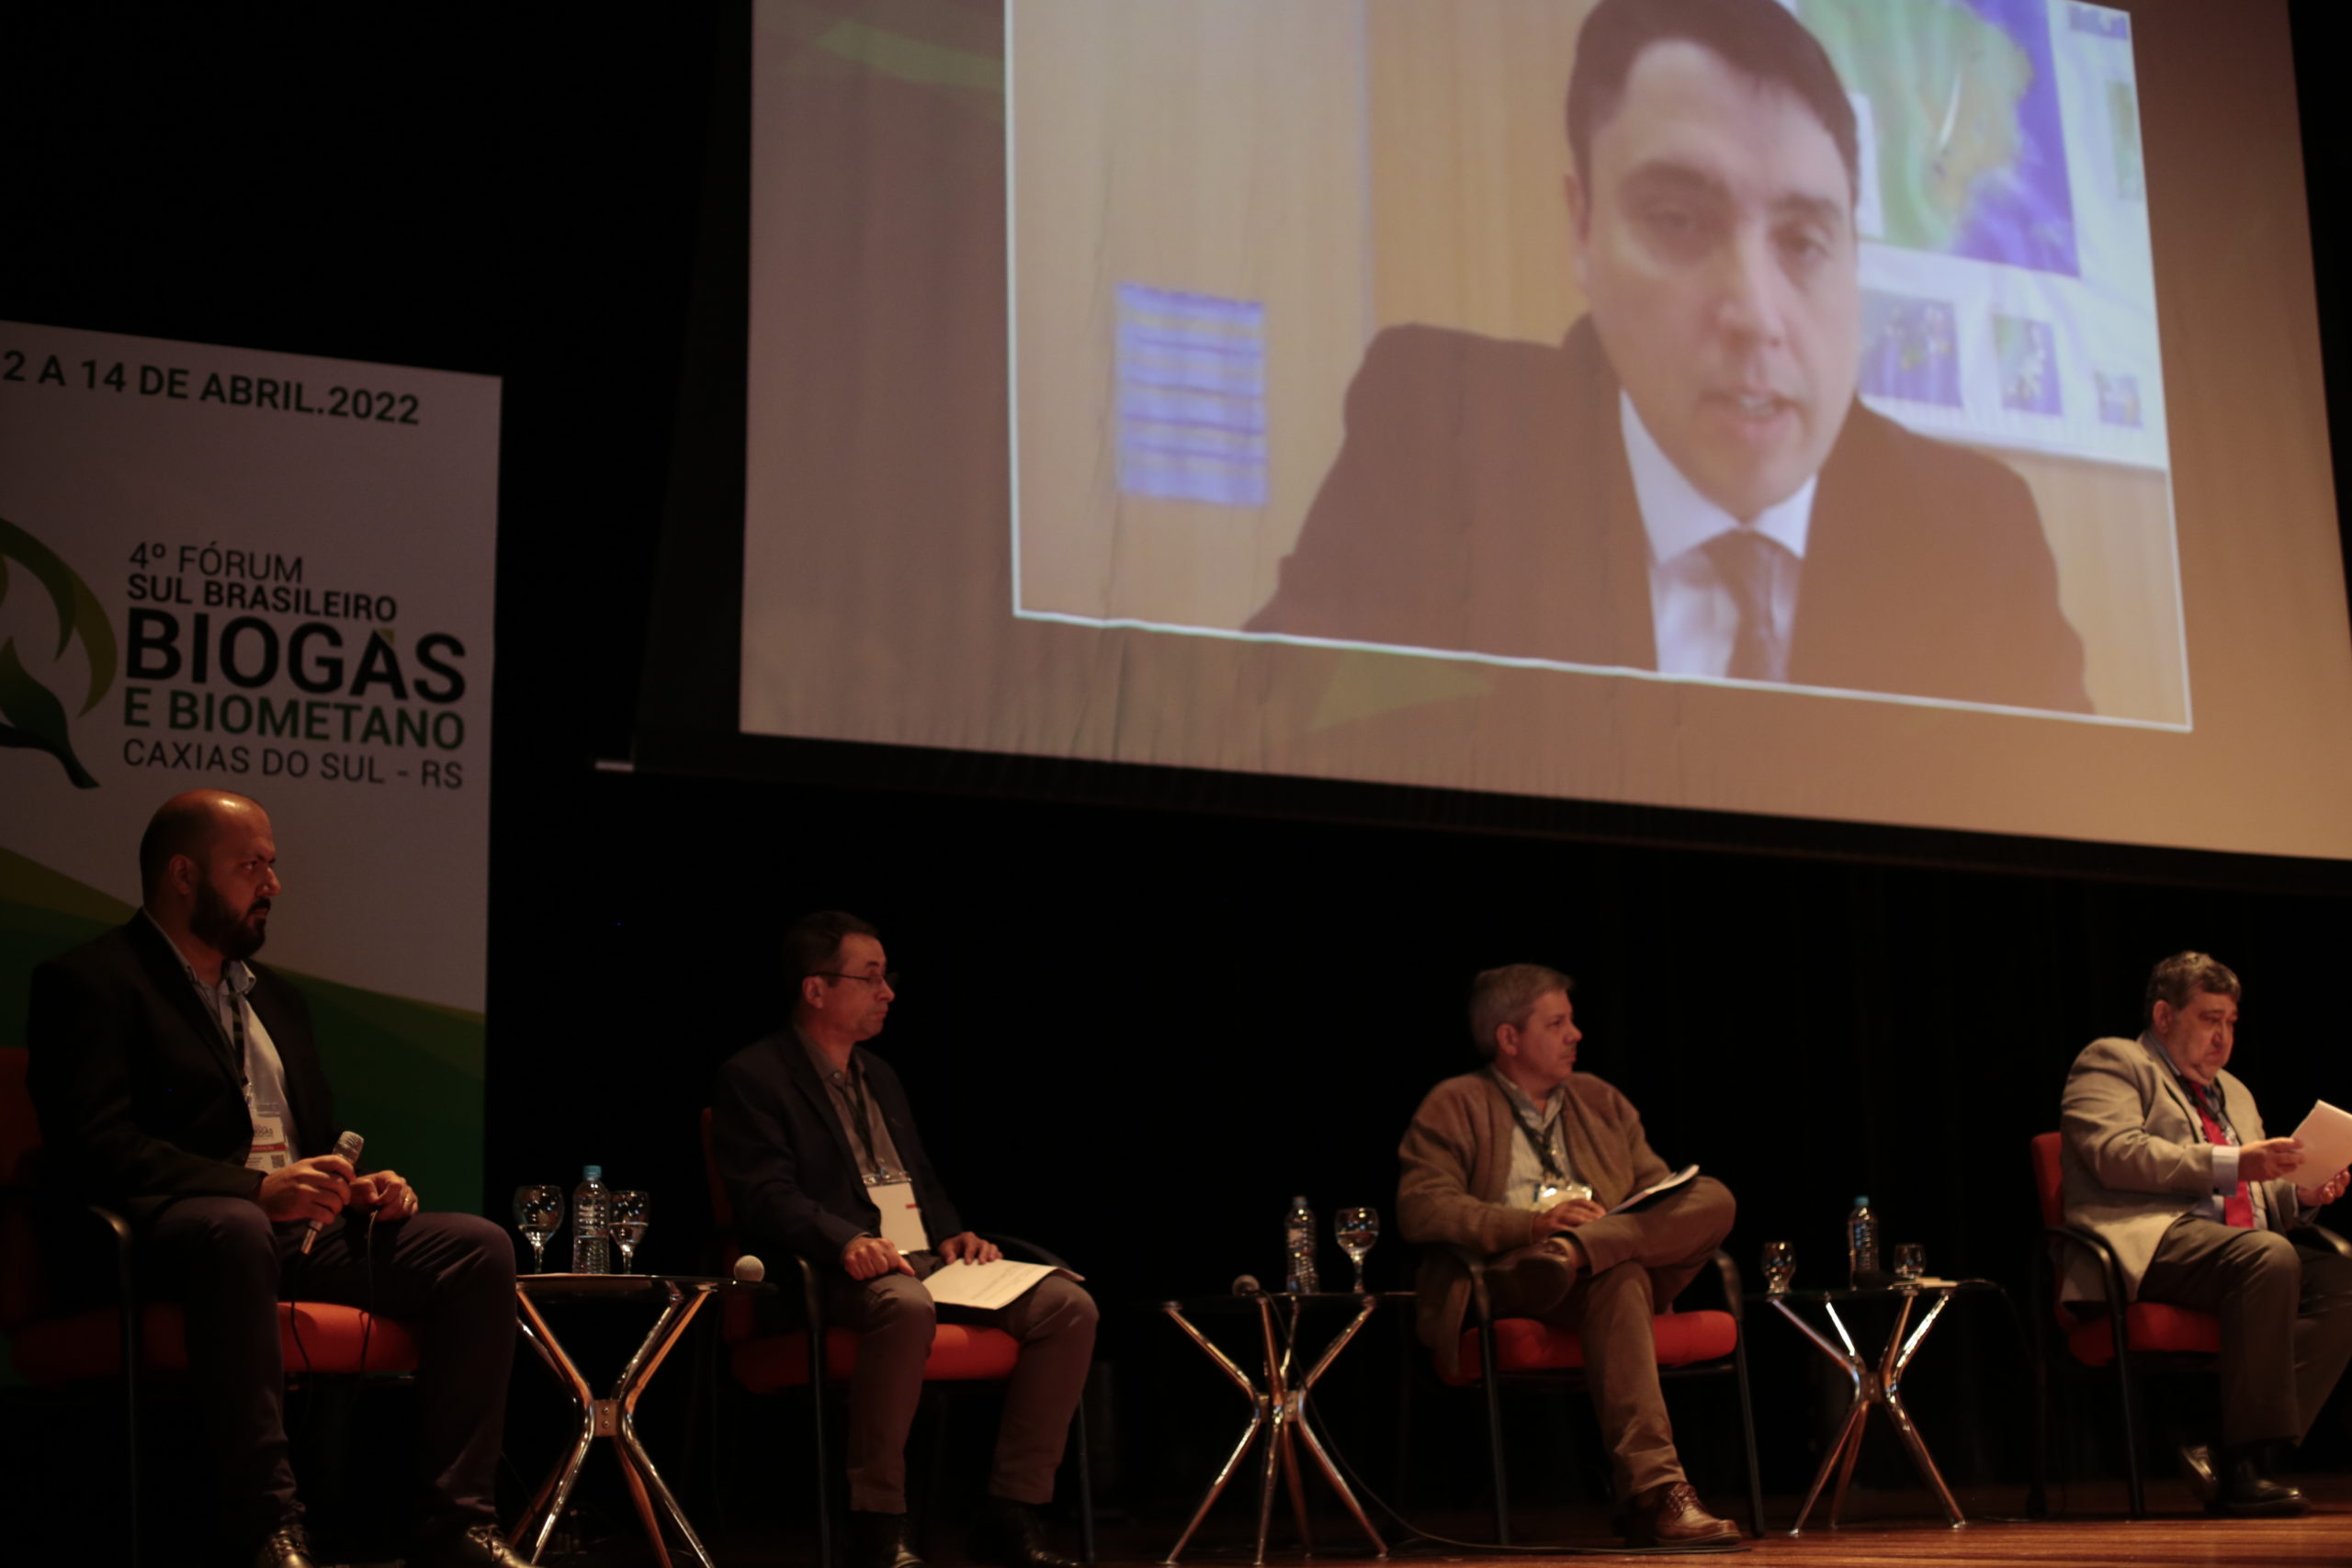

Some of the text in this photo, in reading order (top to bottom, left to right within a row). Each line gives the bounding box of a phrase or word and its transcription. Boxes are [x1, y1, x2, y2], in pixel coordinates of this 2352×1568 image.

[38, 355, 66, 387] A
[81, 362, 127, 393] 14
[139, 365, 190, 400] DE
[198, 373, 420, 426] ABRIL.2022
[178, 537, 303, 584] FÓRUM
[126, 573, 398, 624] SUL BRASILEIRO
[126, 606, 467, 706] BIOGÁS
[123, 686, 466, 751] E BIOMETANO
[123, 739, 251, 776] CAXIAS
[262, 748, 310, 778] DO
[320, 752, 385, 784] SUL
[421, 760, 463, 790] RS
